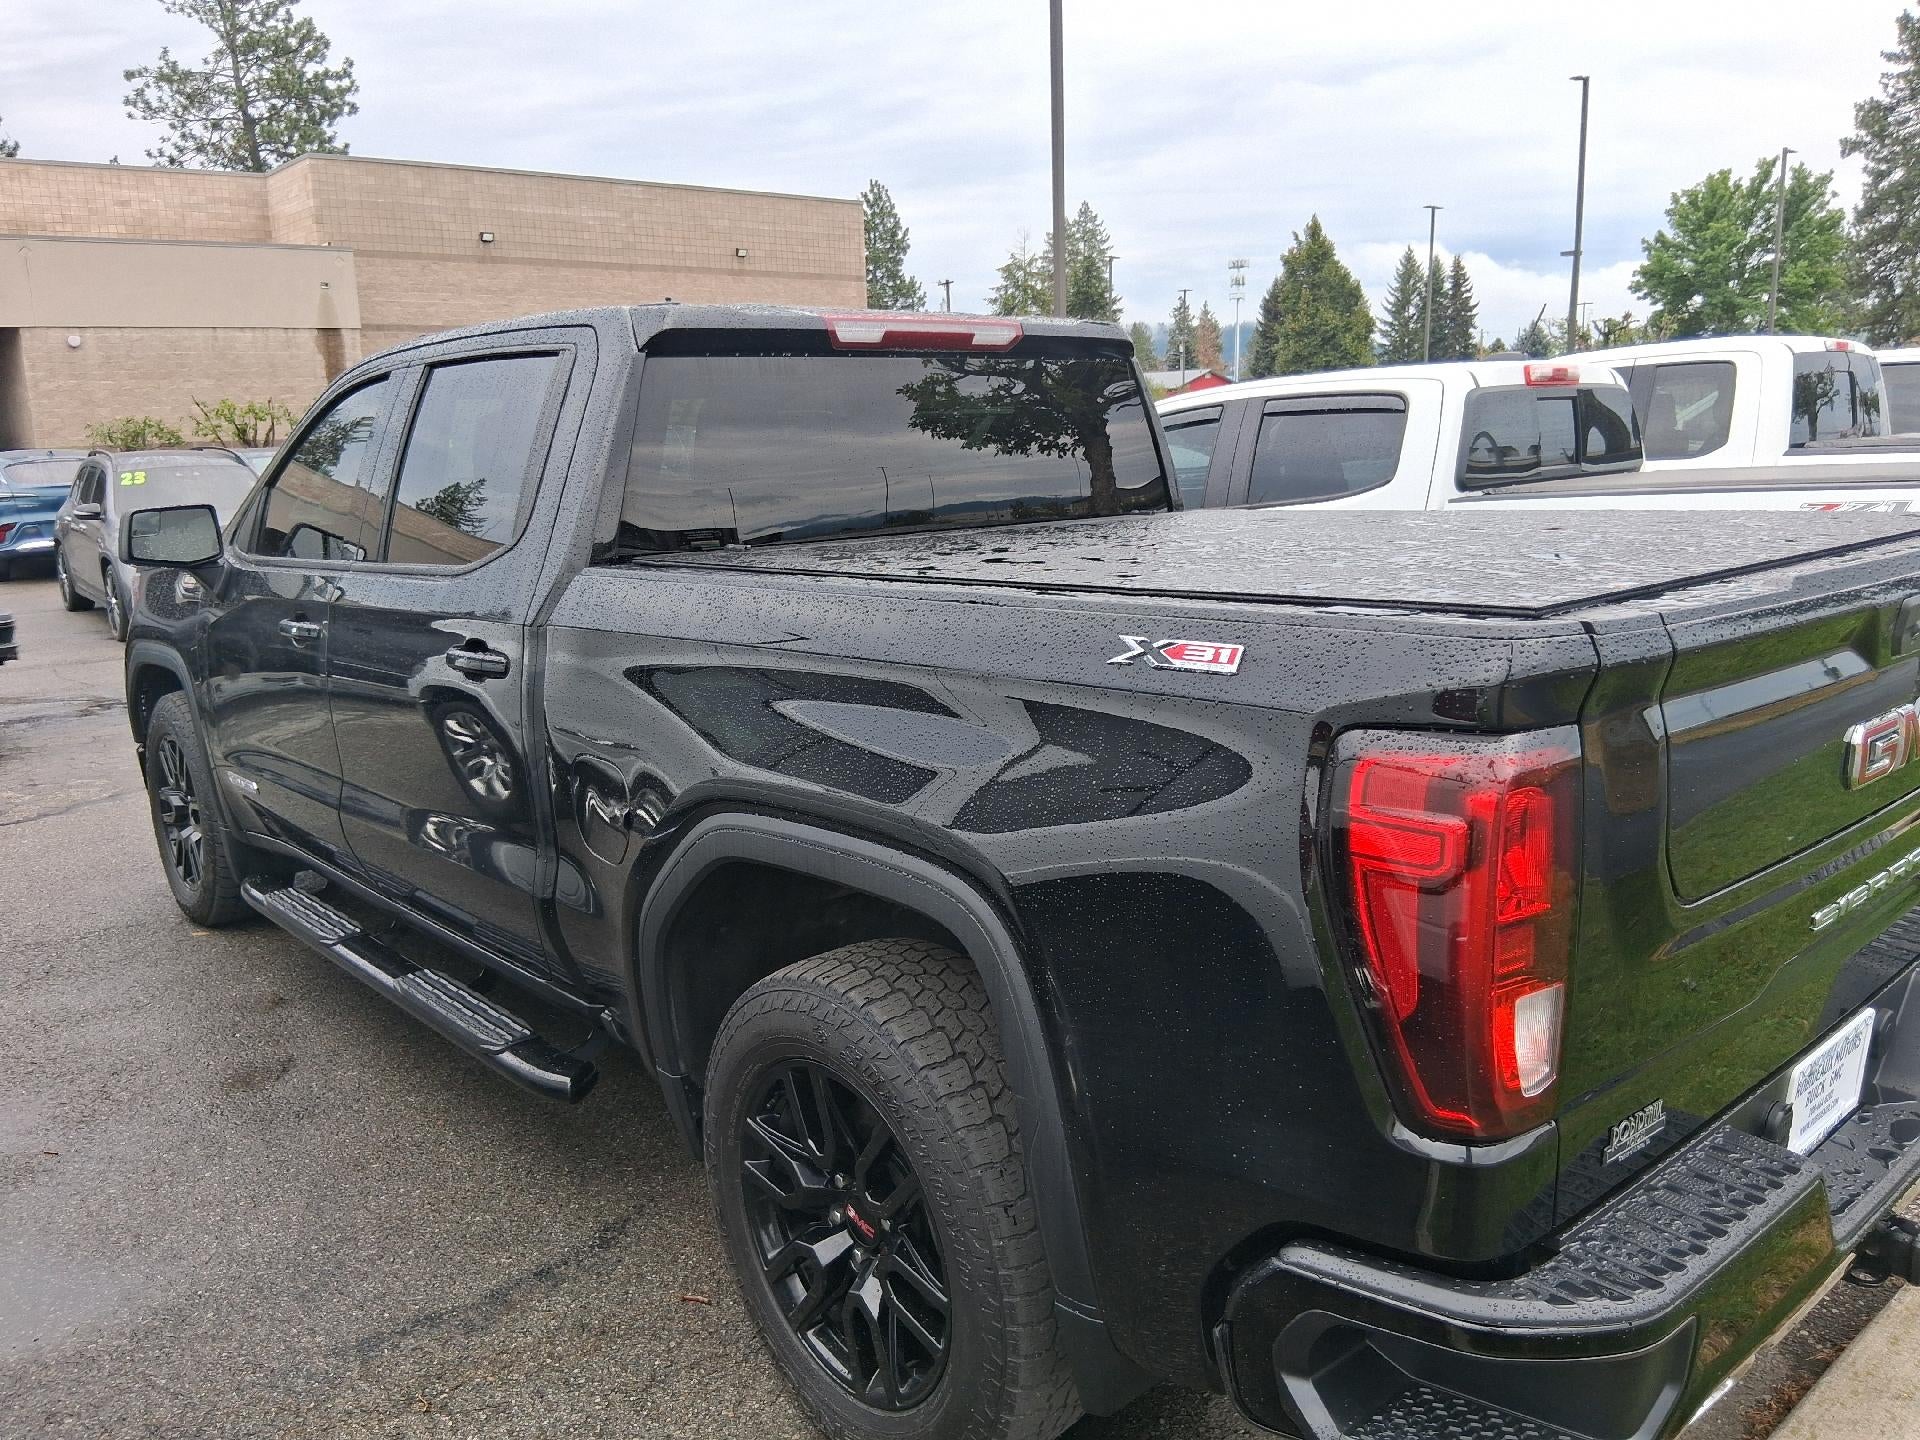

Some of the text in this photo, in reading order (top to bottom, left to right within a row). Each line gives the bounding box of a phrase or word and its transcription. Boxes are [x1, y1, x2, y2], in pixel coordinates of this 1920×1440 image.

[120, 471, 146, 486] 23
[1106, 634, 1245, 677] X31
[846, 1203, 876, 1240] GMC
